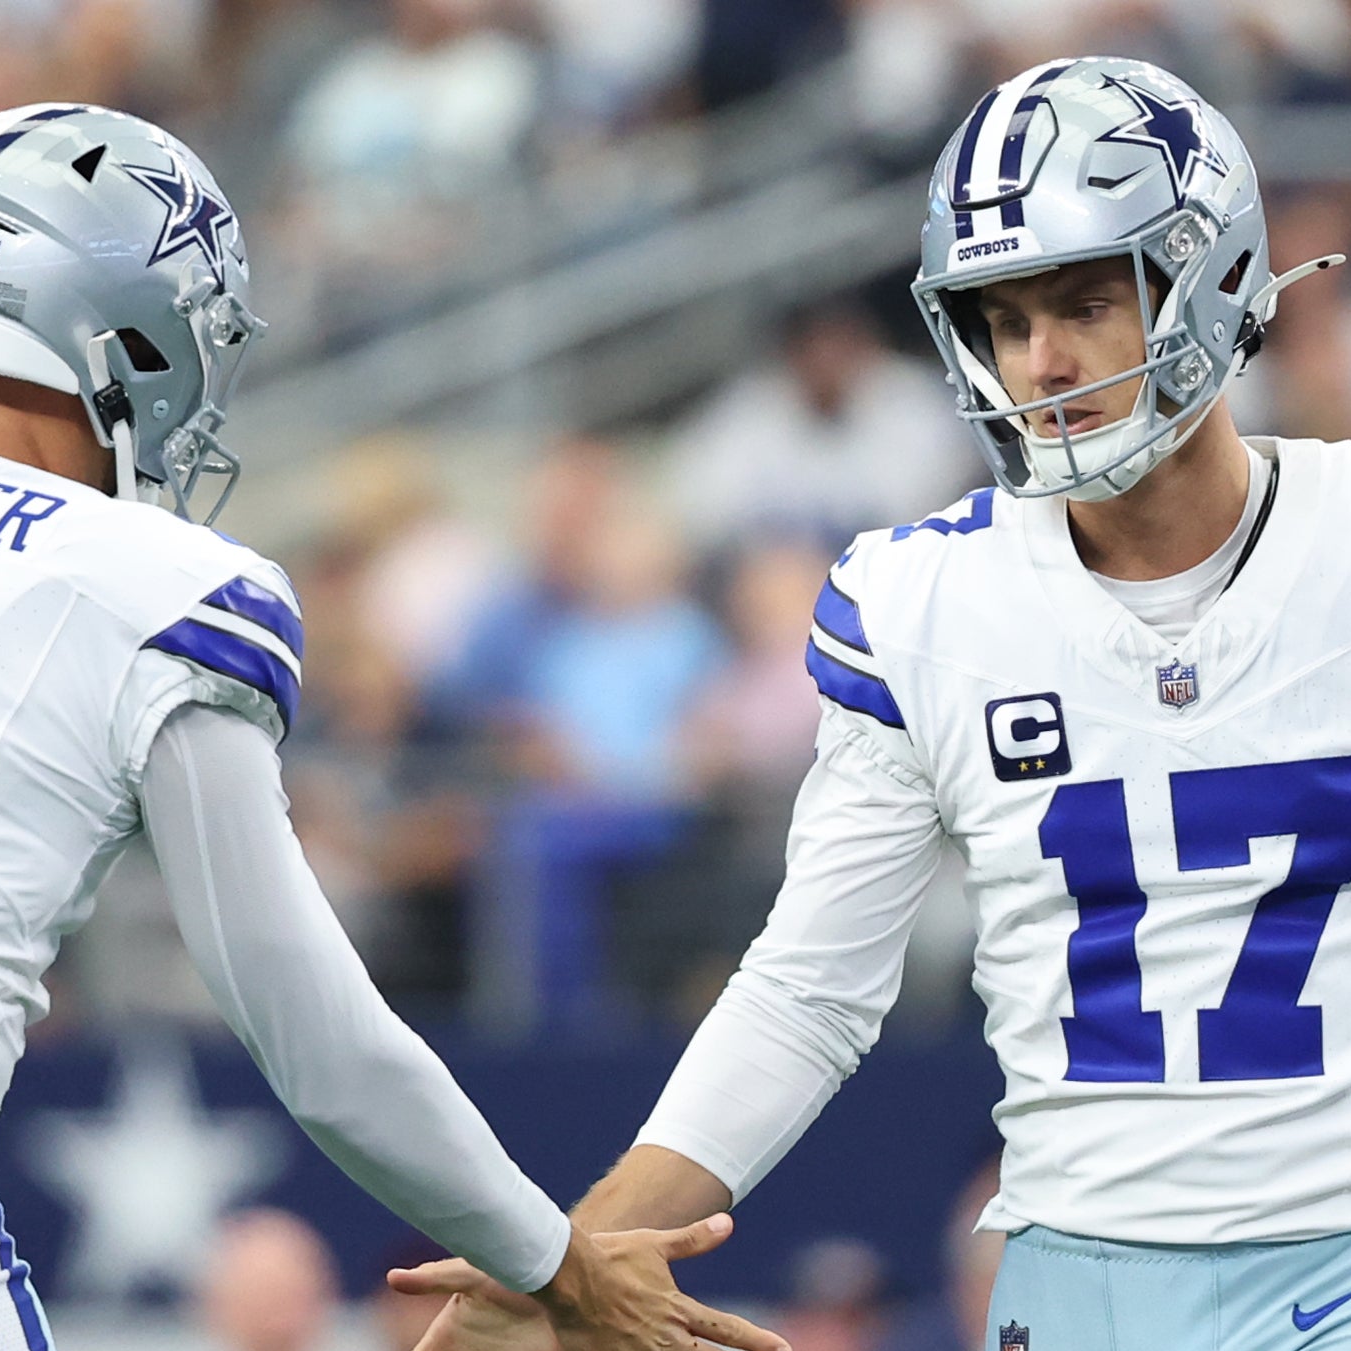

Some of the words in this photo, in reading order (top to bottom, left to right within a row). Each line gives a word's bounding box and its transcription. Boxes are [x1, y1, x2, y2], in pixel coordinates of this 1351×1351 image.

[958, 237, 1019, 261] COWBOYS
[1163, 681, 1196, 704] NFL
[991, 698, 1061, 760] C
